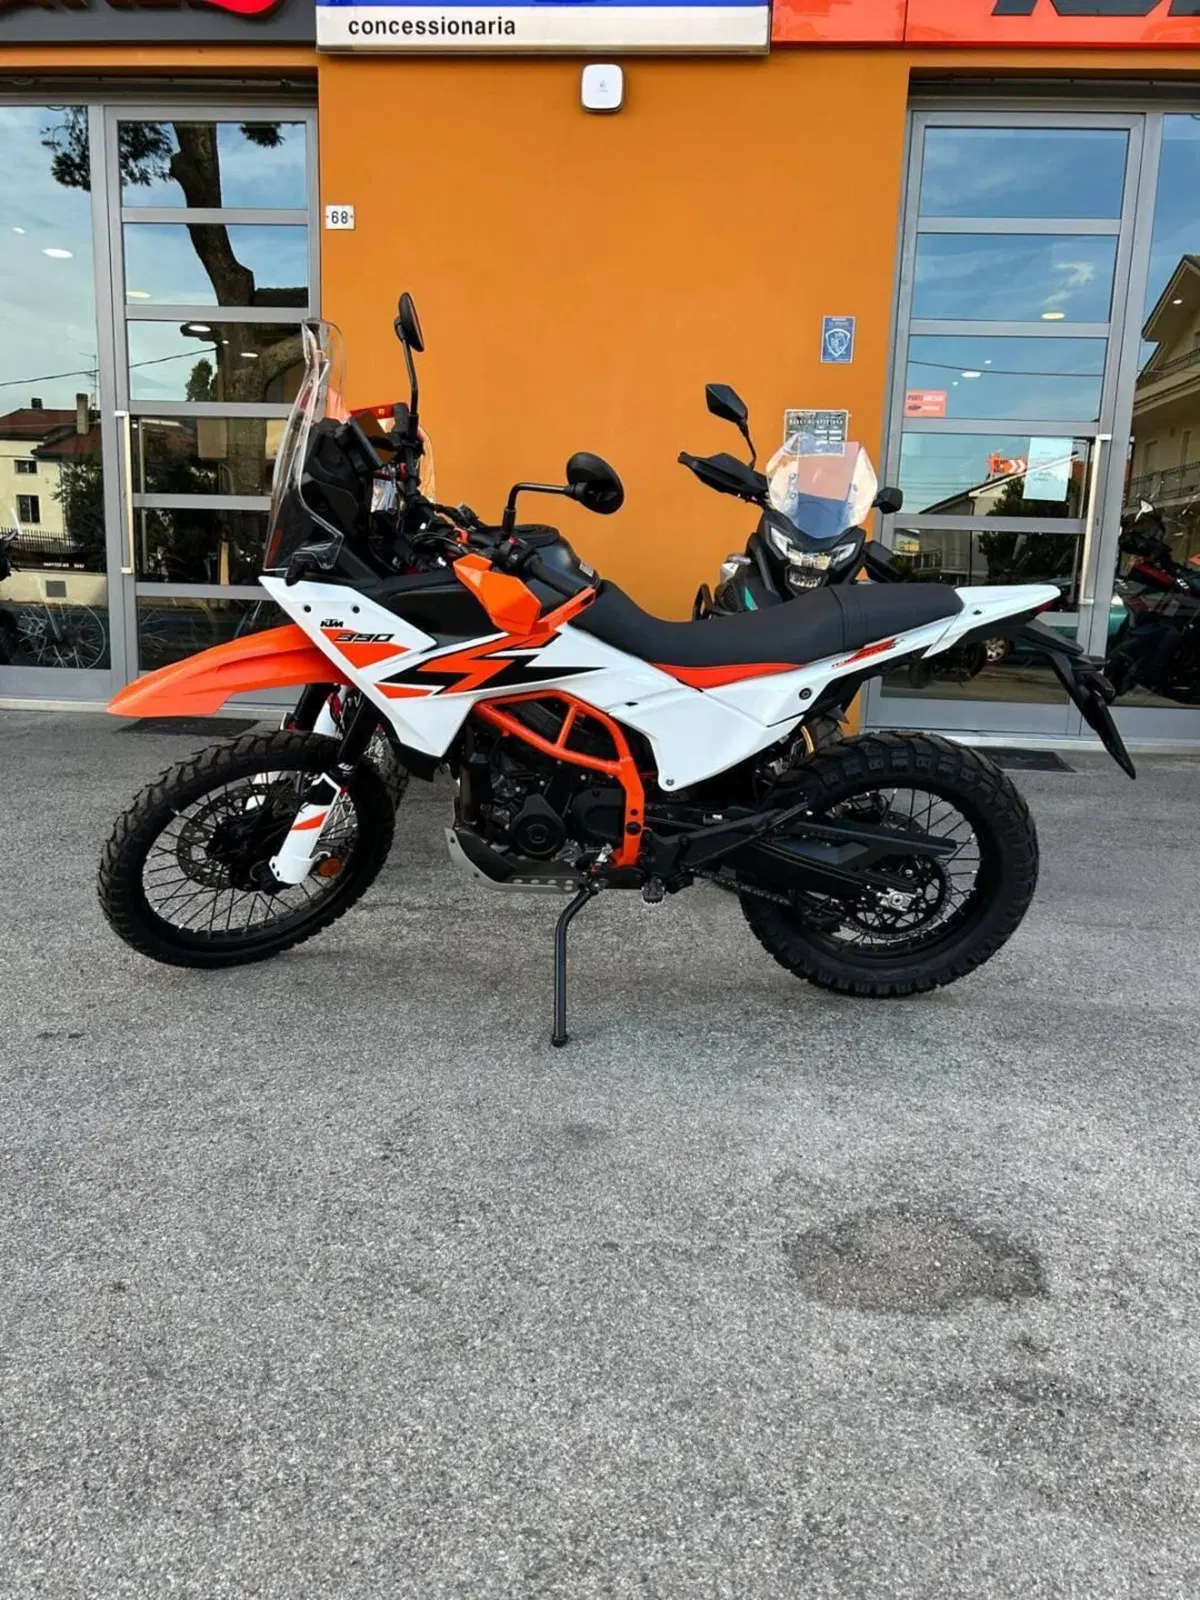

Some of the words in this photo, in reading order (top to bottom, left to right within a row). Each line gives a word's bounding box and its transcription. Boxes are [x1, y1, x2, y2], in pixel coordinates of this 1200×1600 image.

[348, 16, 515, 36] concessionaria
[331, 210, 349, 225] 68
[320, 618, 344, 628] KTM
[334, 632, 395, 643] 390
